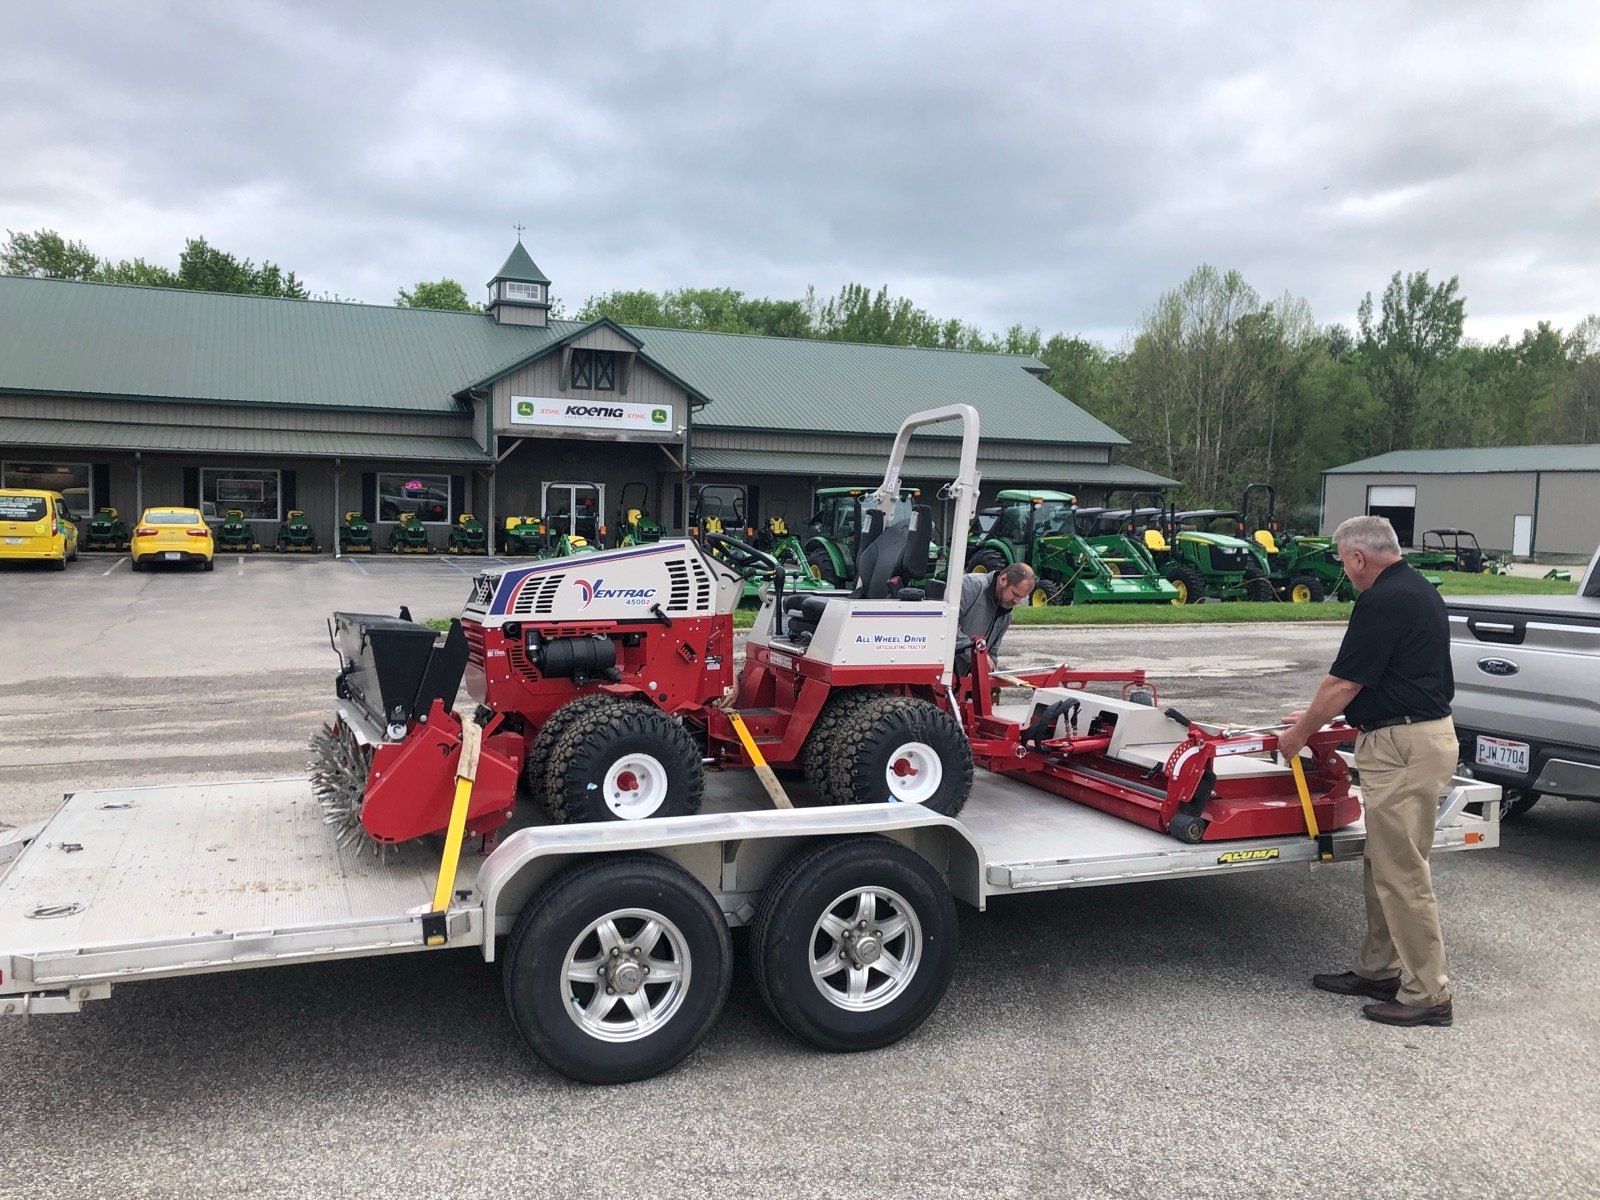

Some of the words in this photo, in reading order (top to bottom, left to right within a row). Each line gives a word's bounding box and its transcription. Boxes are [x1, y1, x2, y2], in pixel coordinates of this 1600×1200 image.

[571, 578, 656, 611] VENTRAC
[856, 635, 871, 643] ALL
[874, 635, 901, 643] WHEEL
[904, 635, 927, 643] DRIVE
[1485, 660, 1509, 673] Ford
[1480, 744, 1497, 760] PJW
[1500, 747, 1524, 765] 7704
[1219, 847, 1278, 862] ALUMA
